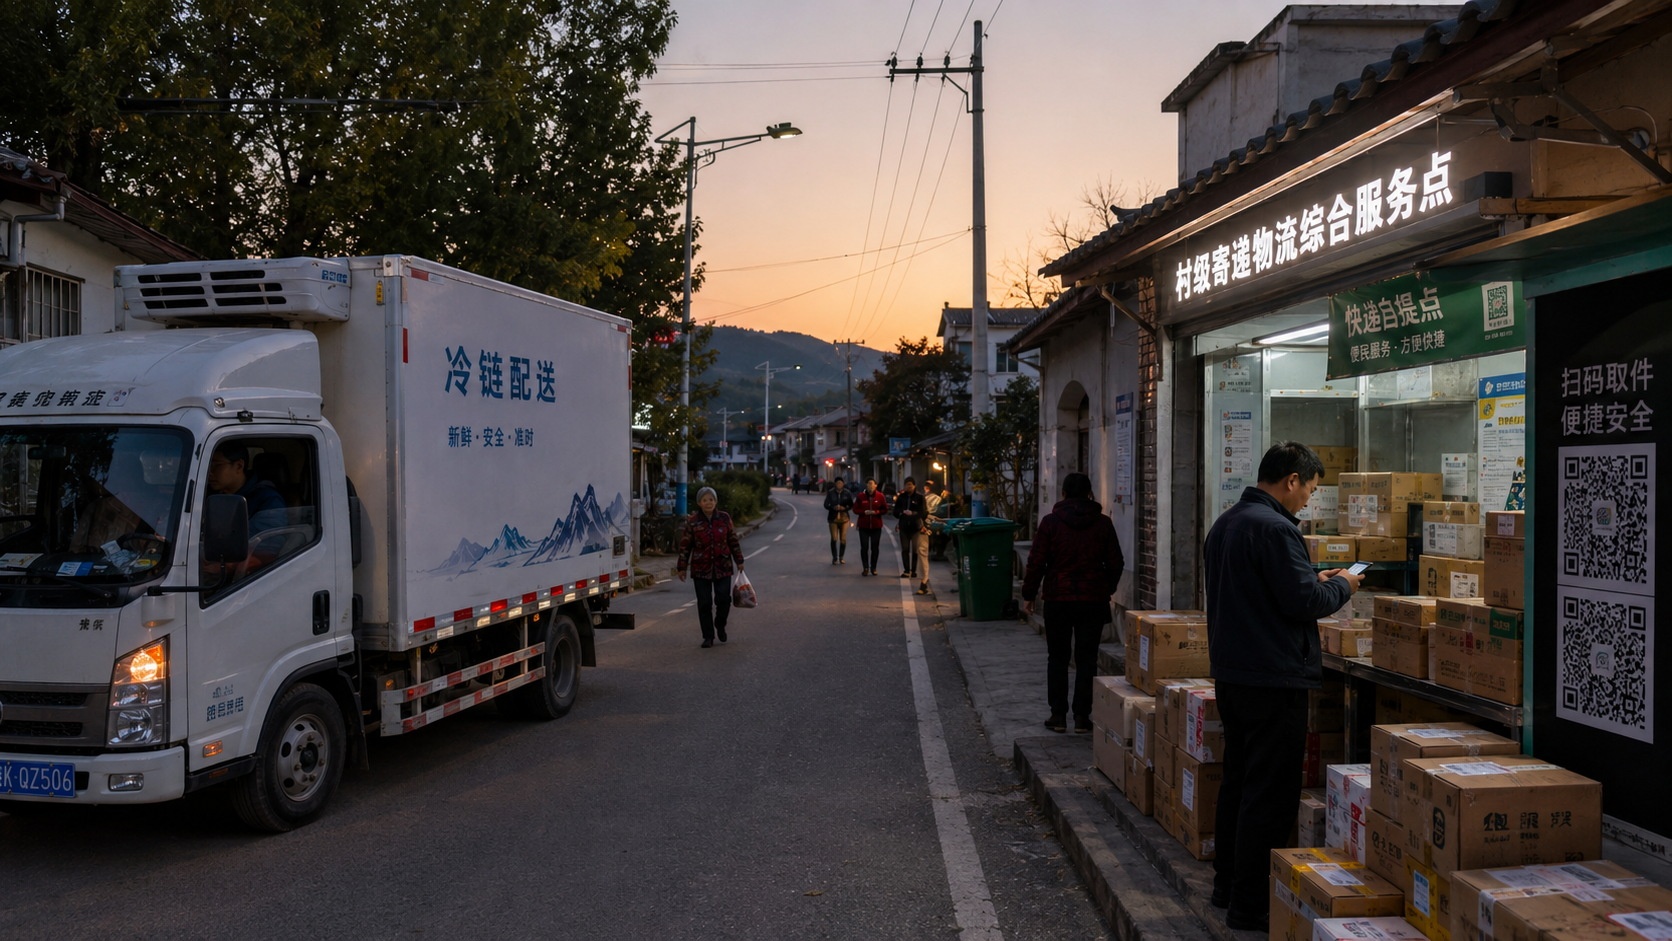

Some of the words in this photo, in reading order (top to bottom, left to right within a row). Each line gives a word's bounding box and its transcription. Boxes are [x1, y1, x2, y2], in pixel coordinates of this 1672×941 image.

[1176, 151, 1453, 302] 村级寄递物流综合服务点
[1345, 286, 1444, 338] 快递自提点
[444, 345, 556, 403] 冷链配送
[1561, 357, 1654, 398] 扫码取件
[1560, 399, 1654, 437] 便捷安全
[0, 765, 72, 791] K·QZ506
